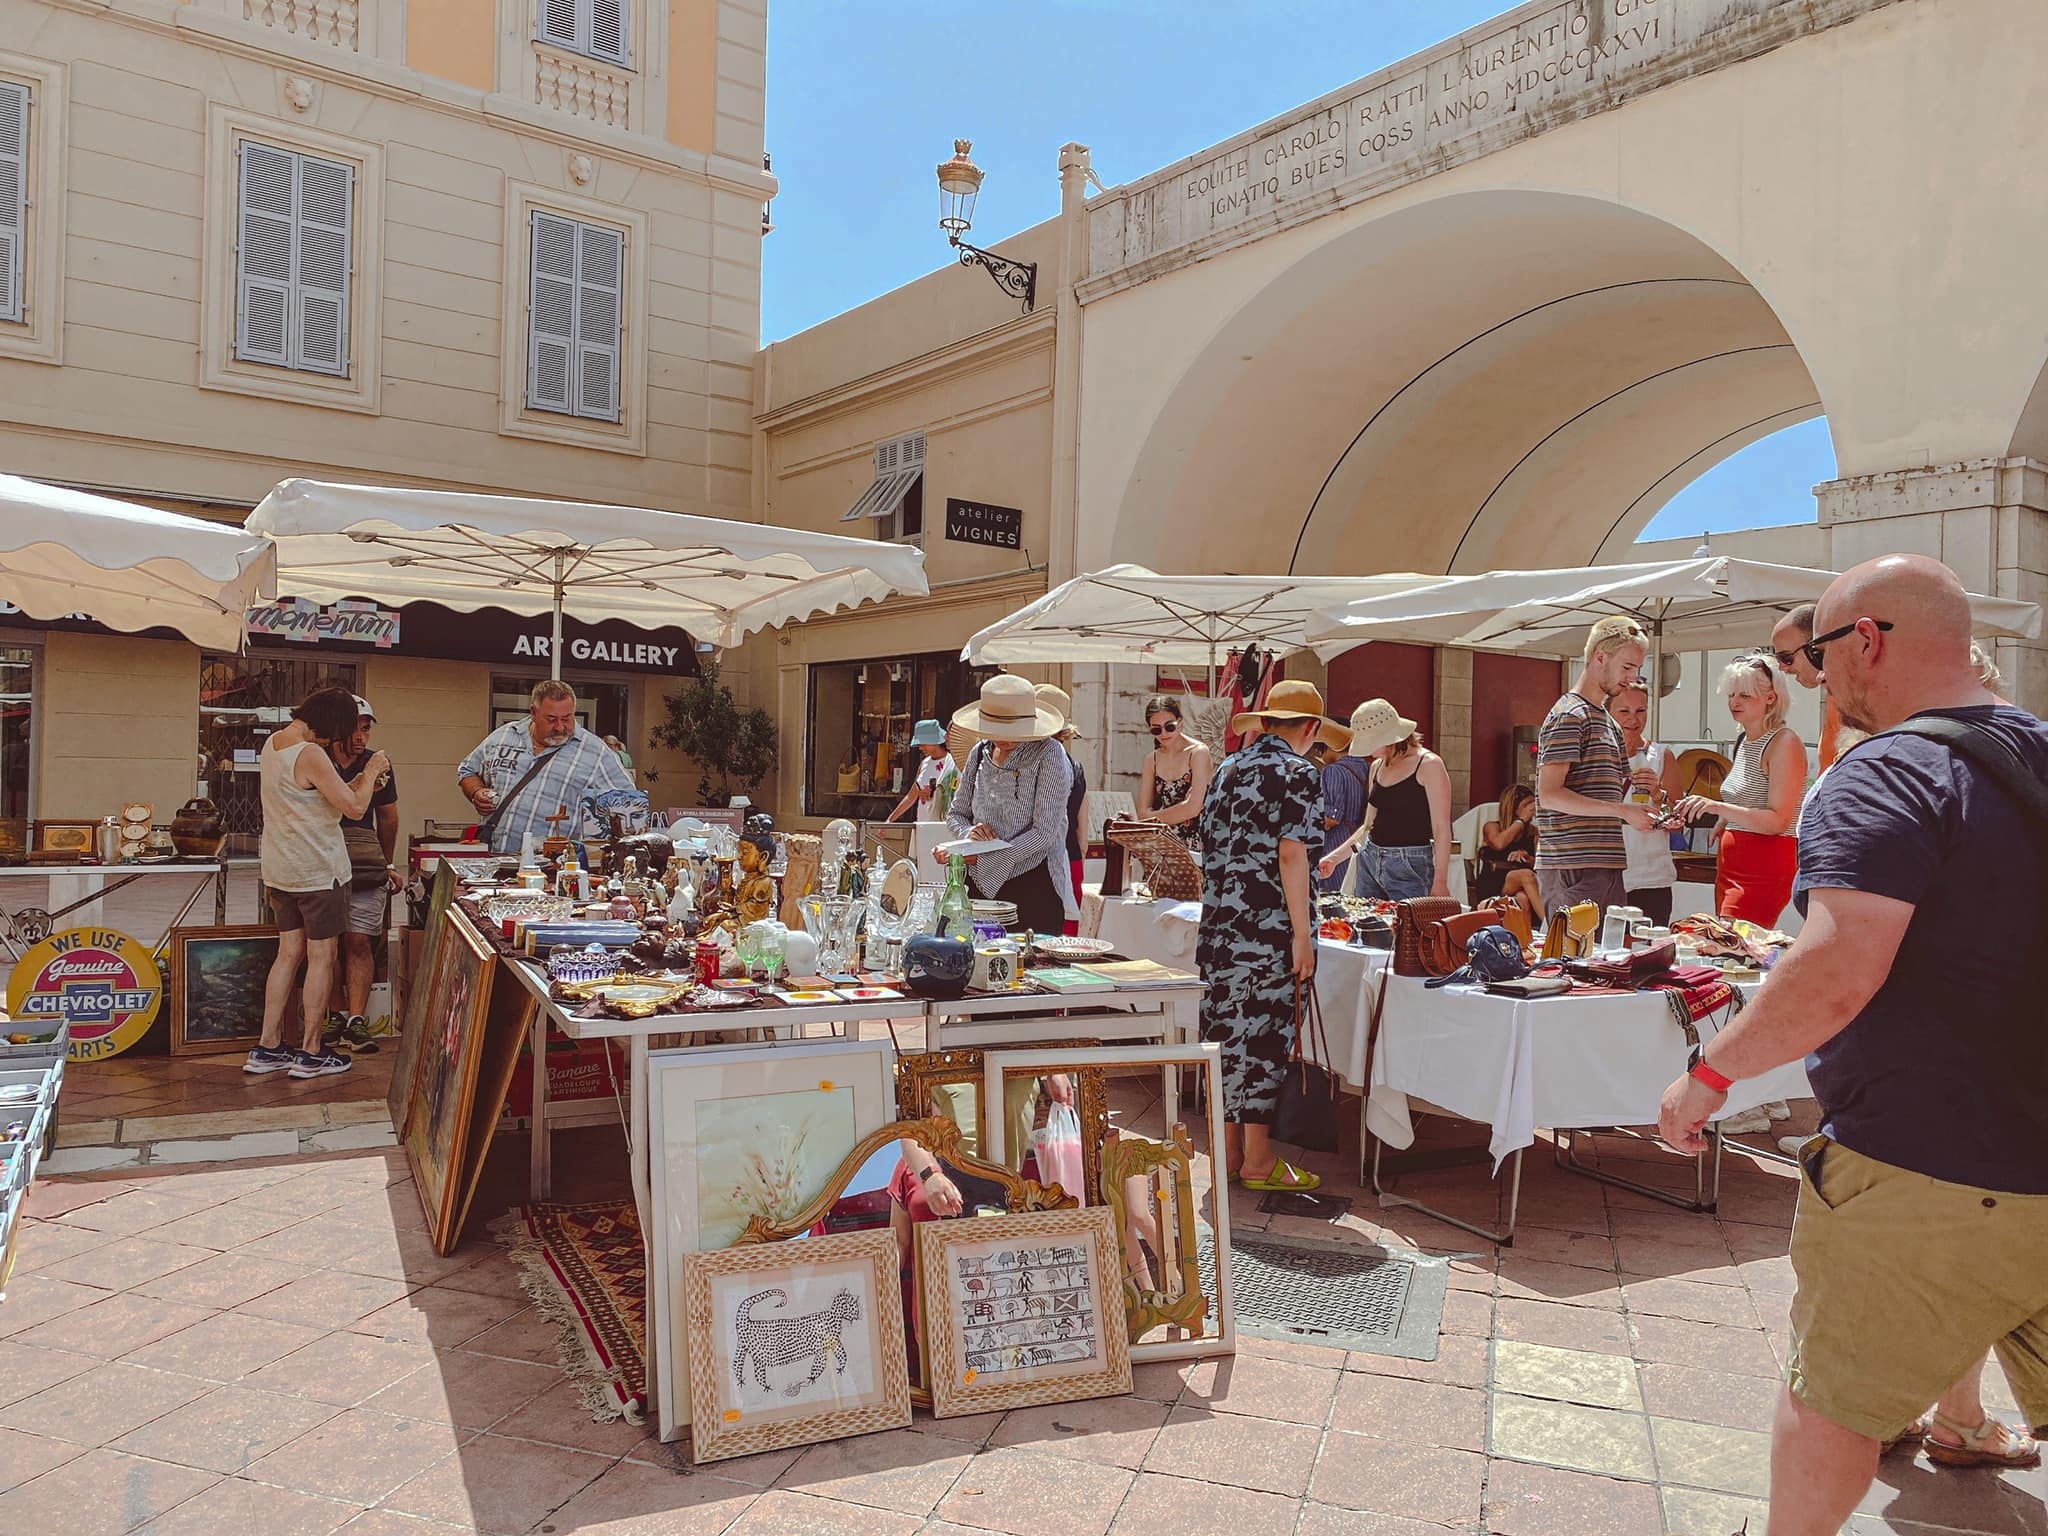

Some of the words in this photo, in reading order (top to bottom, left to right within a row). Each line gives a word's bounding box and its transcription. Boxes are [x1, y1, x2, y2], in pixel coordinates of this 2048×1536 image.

[1187, 159, 1249, 199] EQUITE
[1264, 120, 1342, 166] CAROLO
[1360, 83, 1425, 127] RATTI
[1441, 14, 1589, 94] LAURENTIO
[1210, 176, 1279, 218] IGNATIO
[1291, 149, 1345, 186] BUES
[1359, 121, 1413, 157] COSS
[1427, 90, 1489, 131] ANNO
[1505, 18, 1661, 100] MDCCCXXVI
[959, 507, 1011, 523] atelier
[951, 524, 1017, 545] VIGNES
[571, 638, 679, 666] GALLERY
[50, 933, 82, 953] WE
[90, 931, 126, 952] USE
[48, 959, 125, 982] Genuine
[27, 993, 148, 1013] CHEVROLET
[68, 1036, 116, 1058] ARTS
